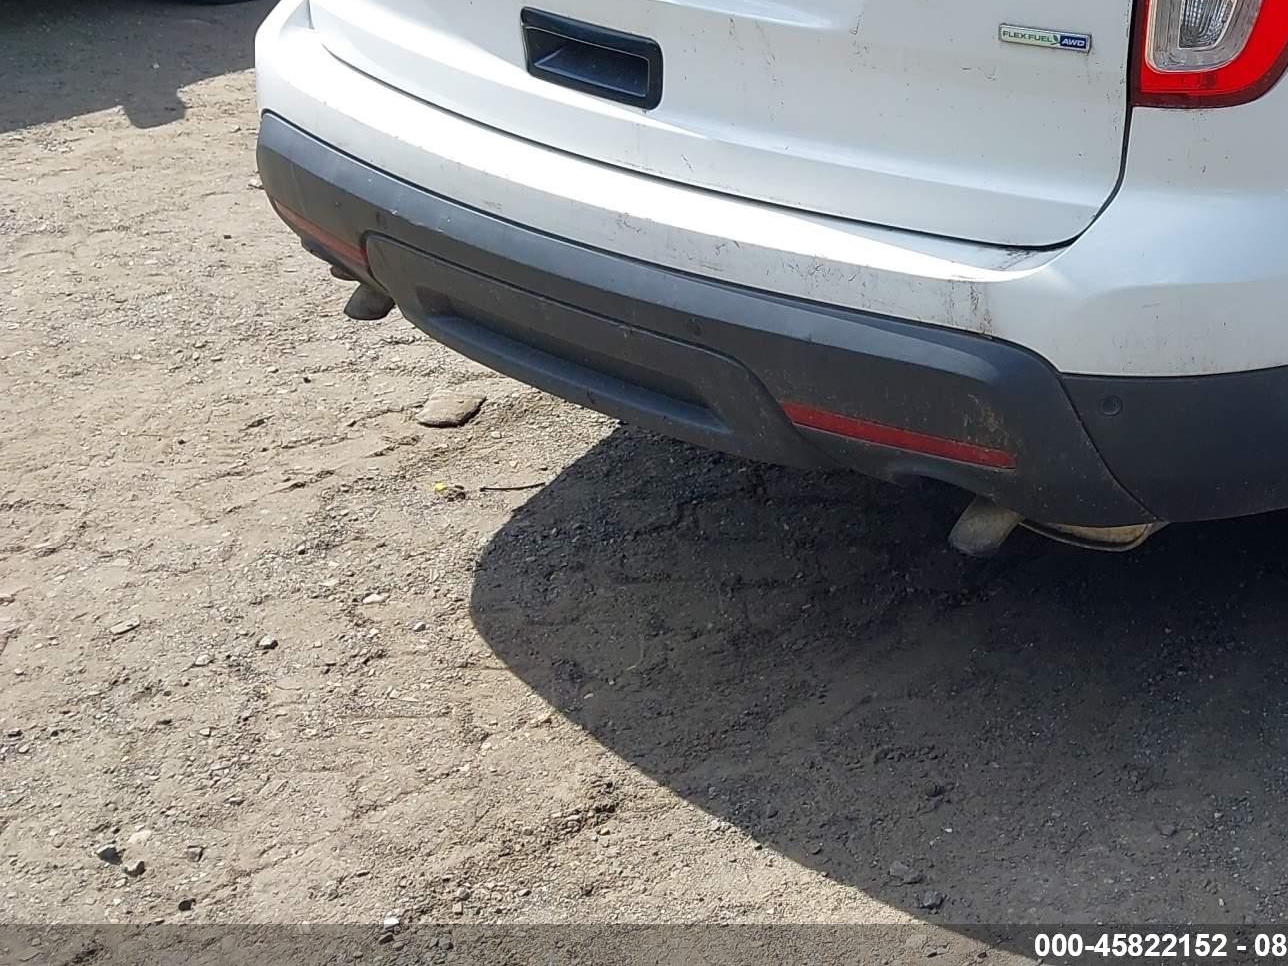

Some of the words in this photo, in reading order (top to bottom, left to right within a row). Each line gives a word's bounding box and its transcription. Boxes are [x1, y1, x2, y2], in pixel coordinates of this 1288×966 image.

[1002, 30, 1026, 40] FLEX
[1028, 34, 1053, 43] FUEL
[1061, 37, 1085, 48] AWD
